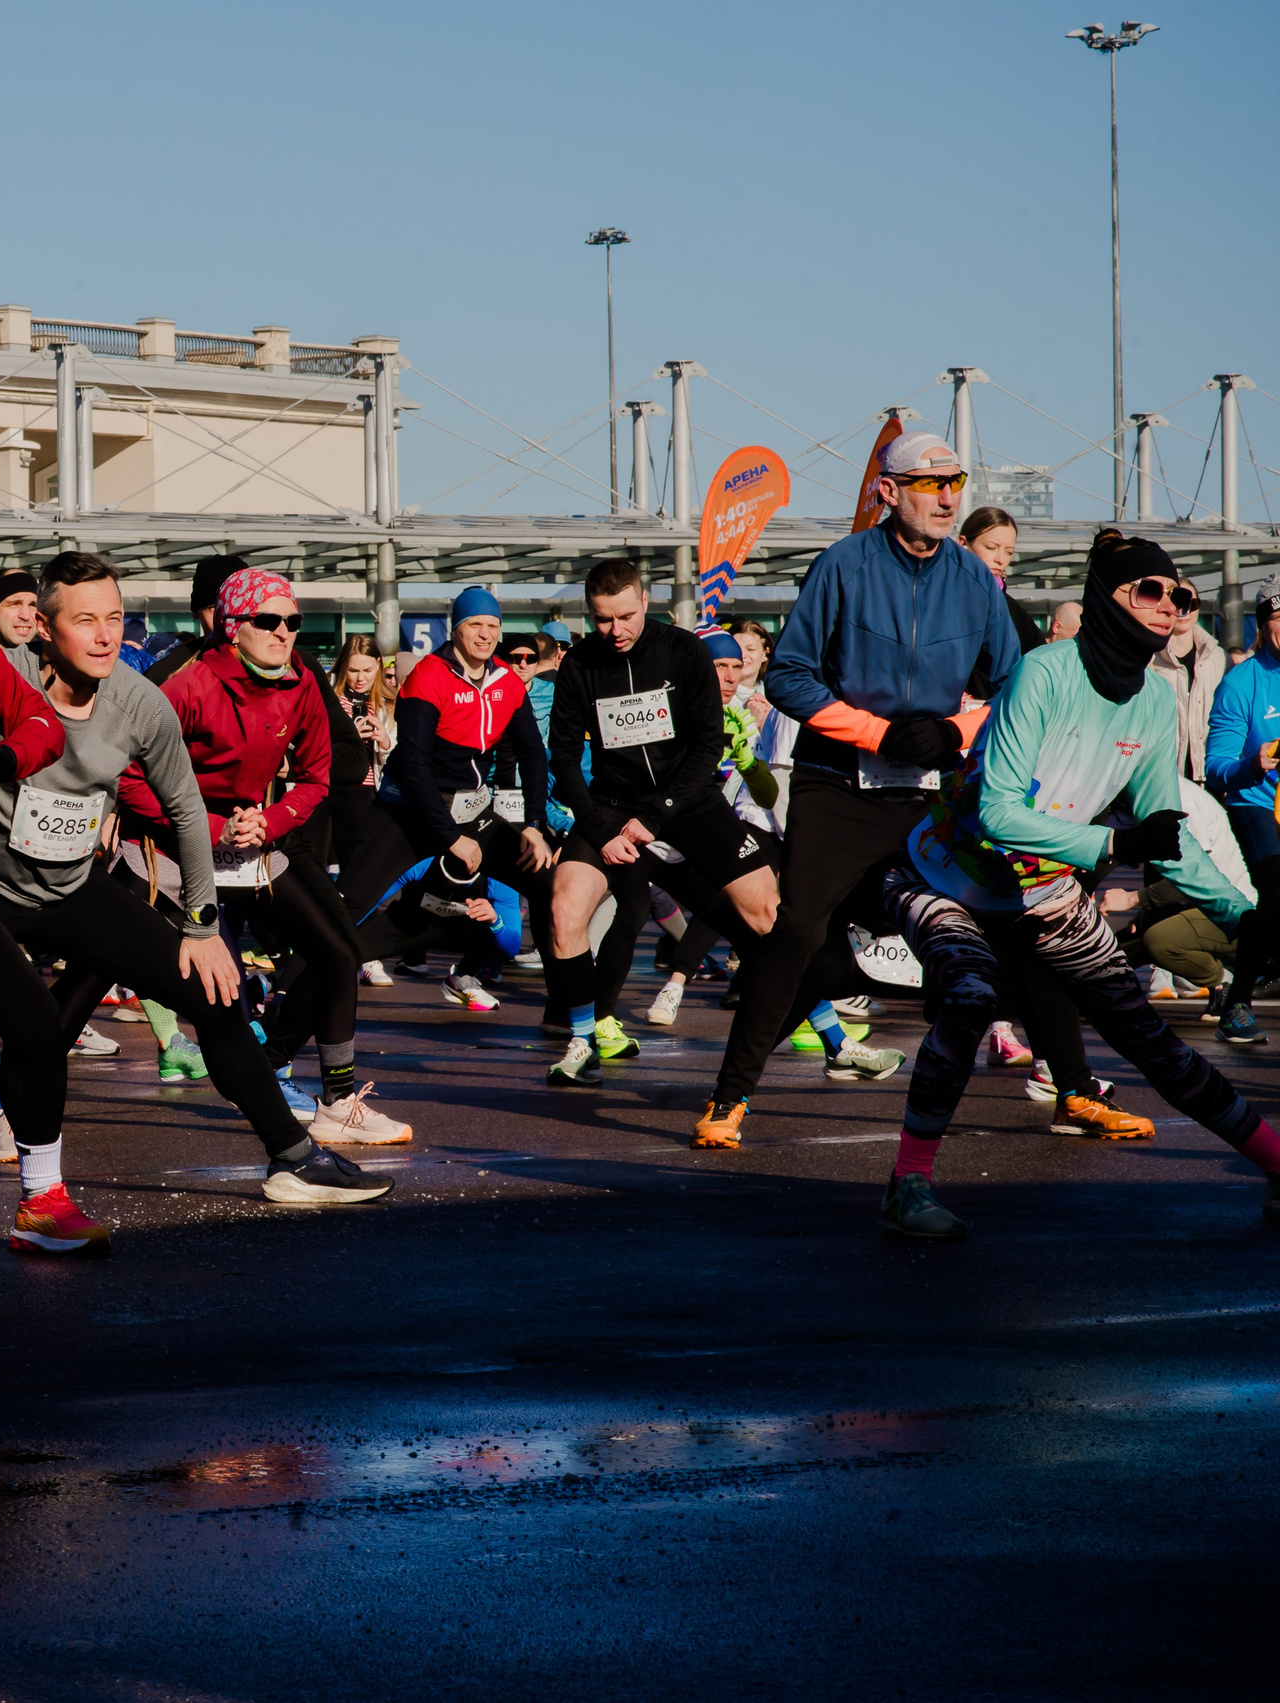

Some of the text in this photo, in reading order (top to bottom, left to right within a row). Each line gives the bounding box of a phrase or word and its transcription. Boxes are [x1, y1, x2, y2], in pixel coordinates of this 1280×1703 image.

[724, 464, 769, 492] АРЕНА
[714, 501, 747, 529] 1:40
[716, 519, 746, 545] 4:44
[412, 623, 433, 658] 5
[620, 697, 643, 706] АРЕНА
[615, 709, 655, 727] 6046
[658, 709, 667, 718] A
[52, 799, 84, 809] АРЕНА
[37, 815, 97, 835] 6285 B
[42, 833, 78, 842] ЕВГЕНИЙ
[212, 850, 245, 865] 805
[435, 904, 459, 915] 6116
